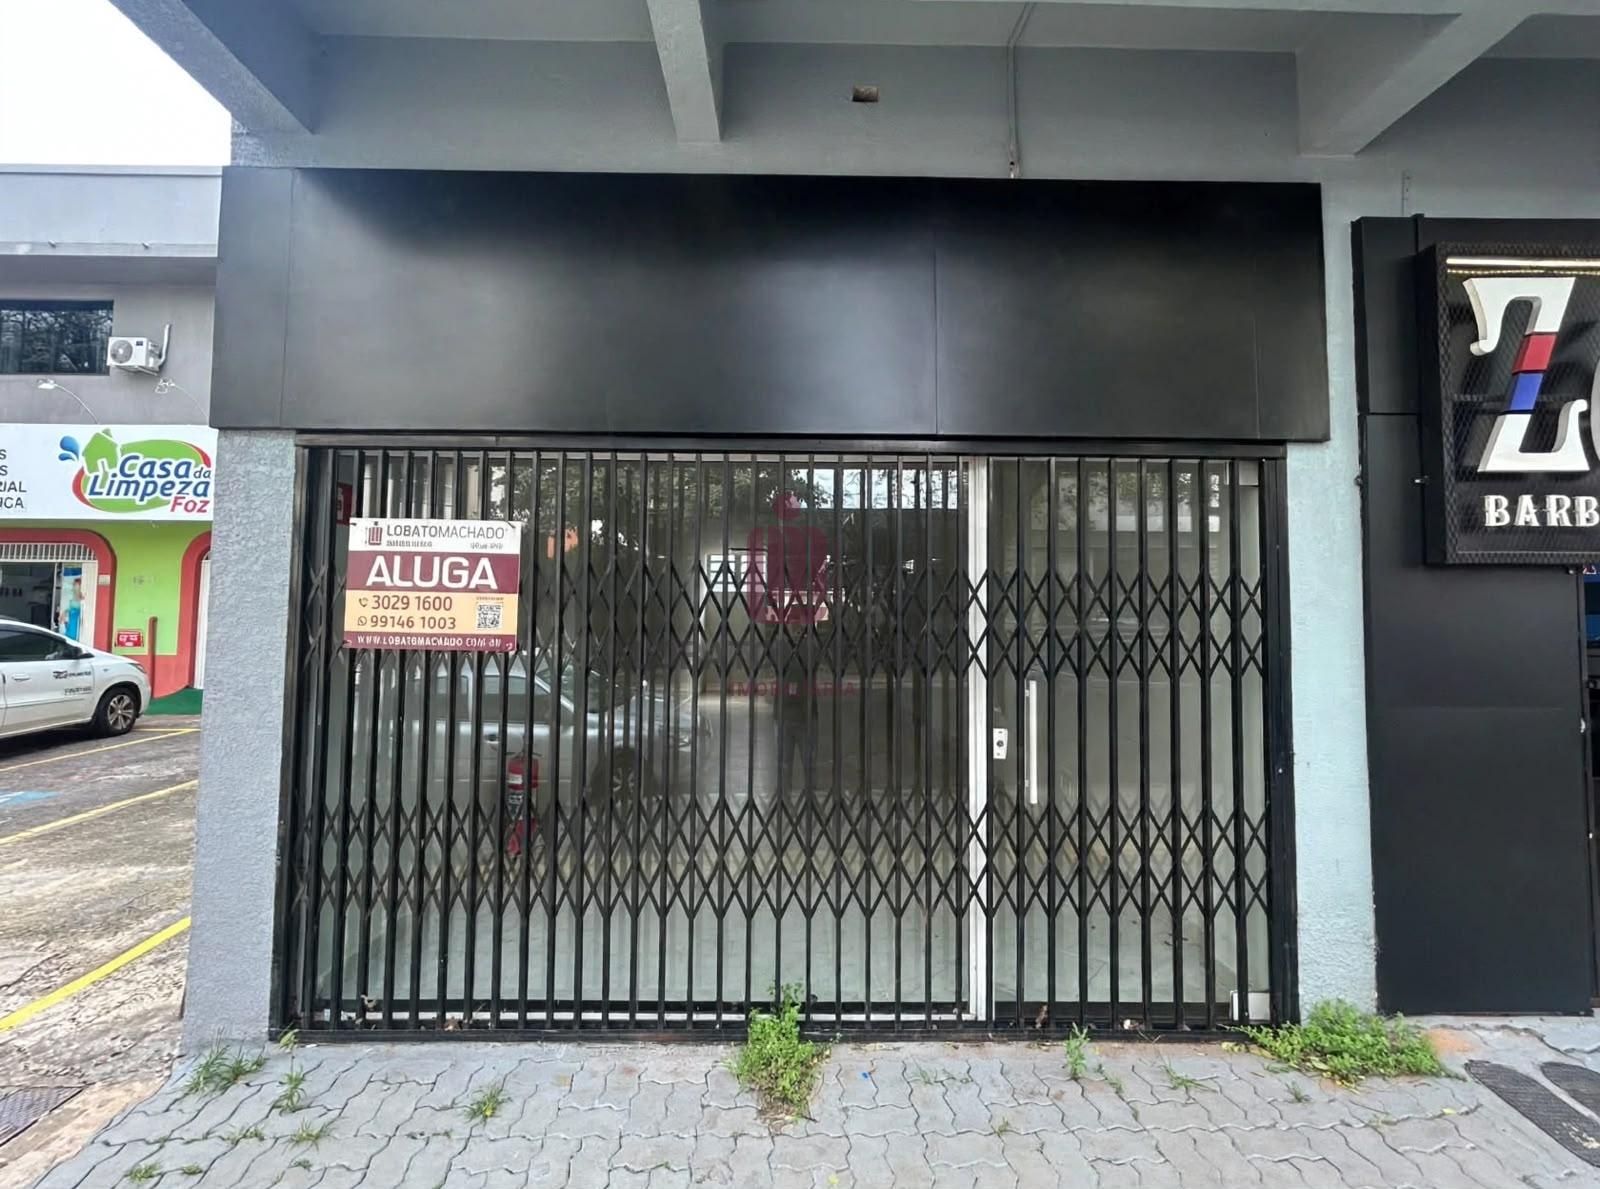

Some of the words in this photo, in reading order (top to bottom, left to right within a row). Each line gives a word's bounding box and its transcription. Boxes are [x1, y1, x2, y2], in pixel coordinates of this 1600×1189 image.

[1463, 277, 1600, 473] Z
[119, 455, 192, 479] Casa
[194, 467, 211, 479] da
[88, 473, 210, 502] Limpeza
[366, 555, 498, 589] ALUGA
[372, 594, 410, 611] 3029
[416, 596, 453, 612] 1600
[370, 615, 415, 629] 99146
[421, 616, 456, 630] 1003
